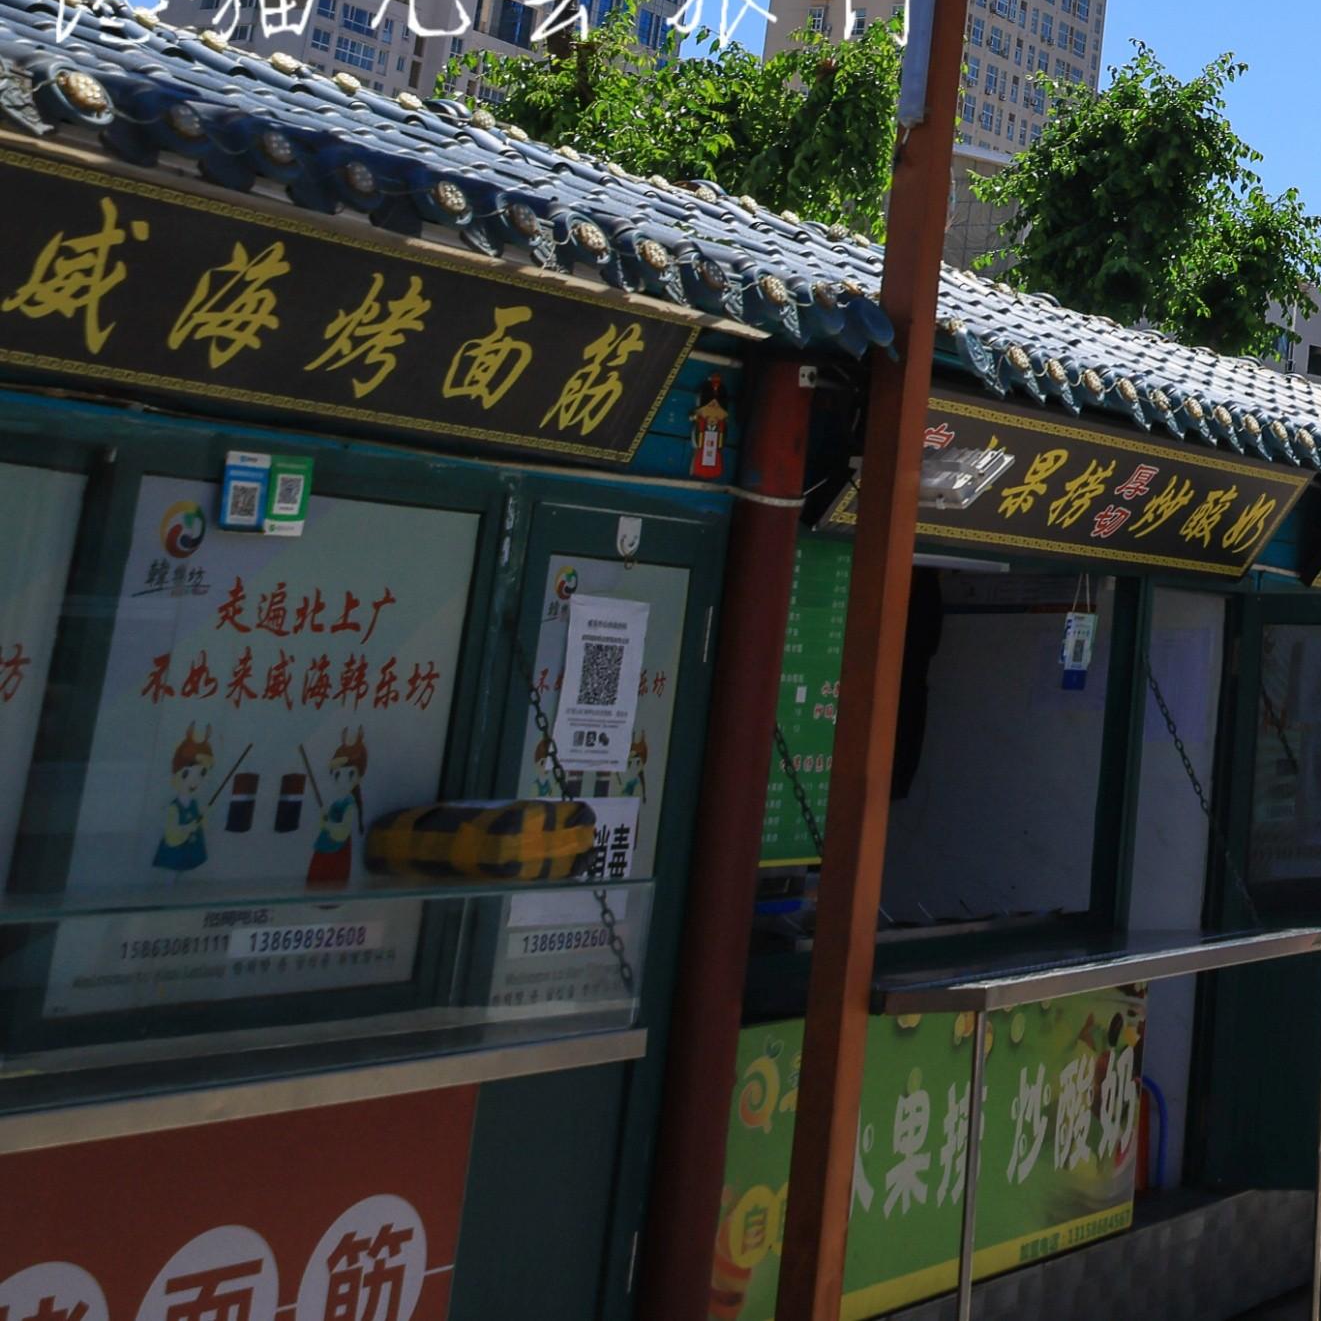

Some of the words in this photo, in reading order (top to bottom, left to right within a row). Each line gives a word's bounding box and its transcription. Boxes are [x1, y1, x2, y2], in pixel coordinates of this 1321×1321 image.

[3, 194, 646, 435] 威海烤面筋
[1090, 464, 1160, 539] 厚切
[1127, 474, 1276, 554] 炒酸奶
[214, 575, 397, 645] 走遍北上广
[141, 645, 442, 712] 不如来威海韩乐坊
[248, 925, 367, 953] 13869892608
[1006, 1044, 1138, 1186] 炒酸奶
